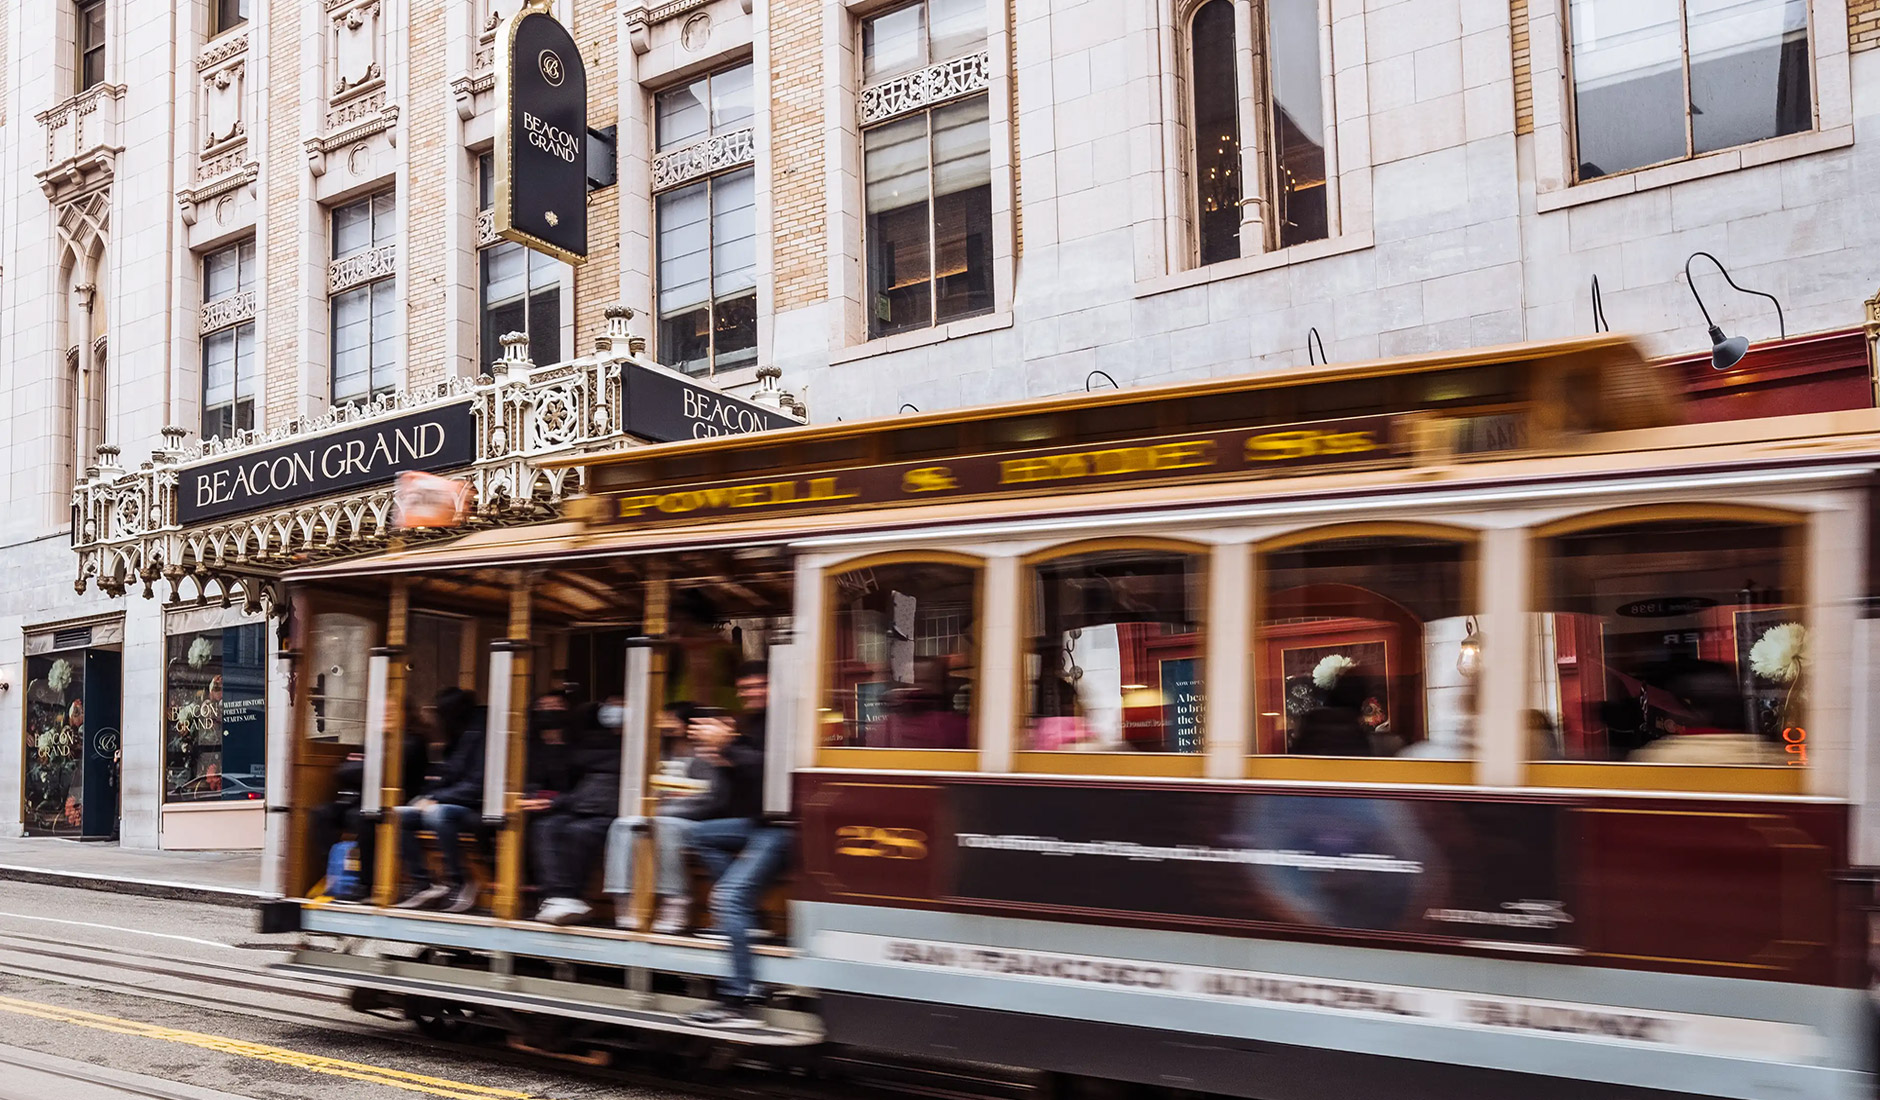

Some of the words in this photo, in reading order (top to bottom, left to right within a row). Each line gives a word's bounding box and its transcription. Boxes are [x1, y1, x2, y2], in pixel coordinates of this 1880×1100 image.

[524, 112, 579, 154] BEACON
[529, 131, 575, 163] GRAND
[683, 388, 767, 434] BEACON
[196, 449, 315, 508] BEACON
[321, 422, 445, 479] GRAND
[223, 701, 242, 709] WHERE
[243, 698, 265, 707] HISTORY
[1177, 693, 1185, 703] A
[223, 707, 247, 716] FOREVER
[1177, 705, 1187, 714] to
[175, 717, 214, 732] GRAND
[223, 715, 243, 723] STARTS
[1178, 715, 1194, 725] the
[1178, 725, 1197, 736] and
[1178, 737, 1191, 747] its
[37, 744, 71, 759] GRAND
